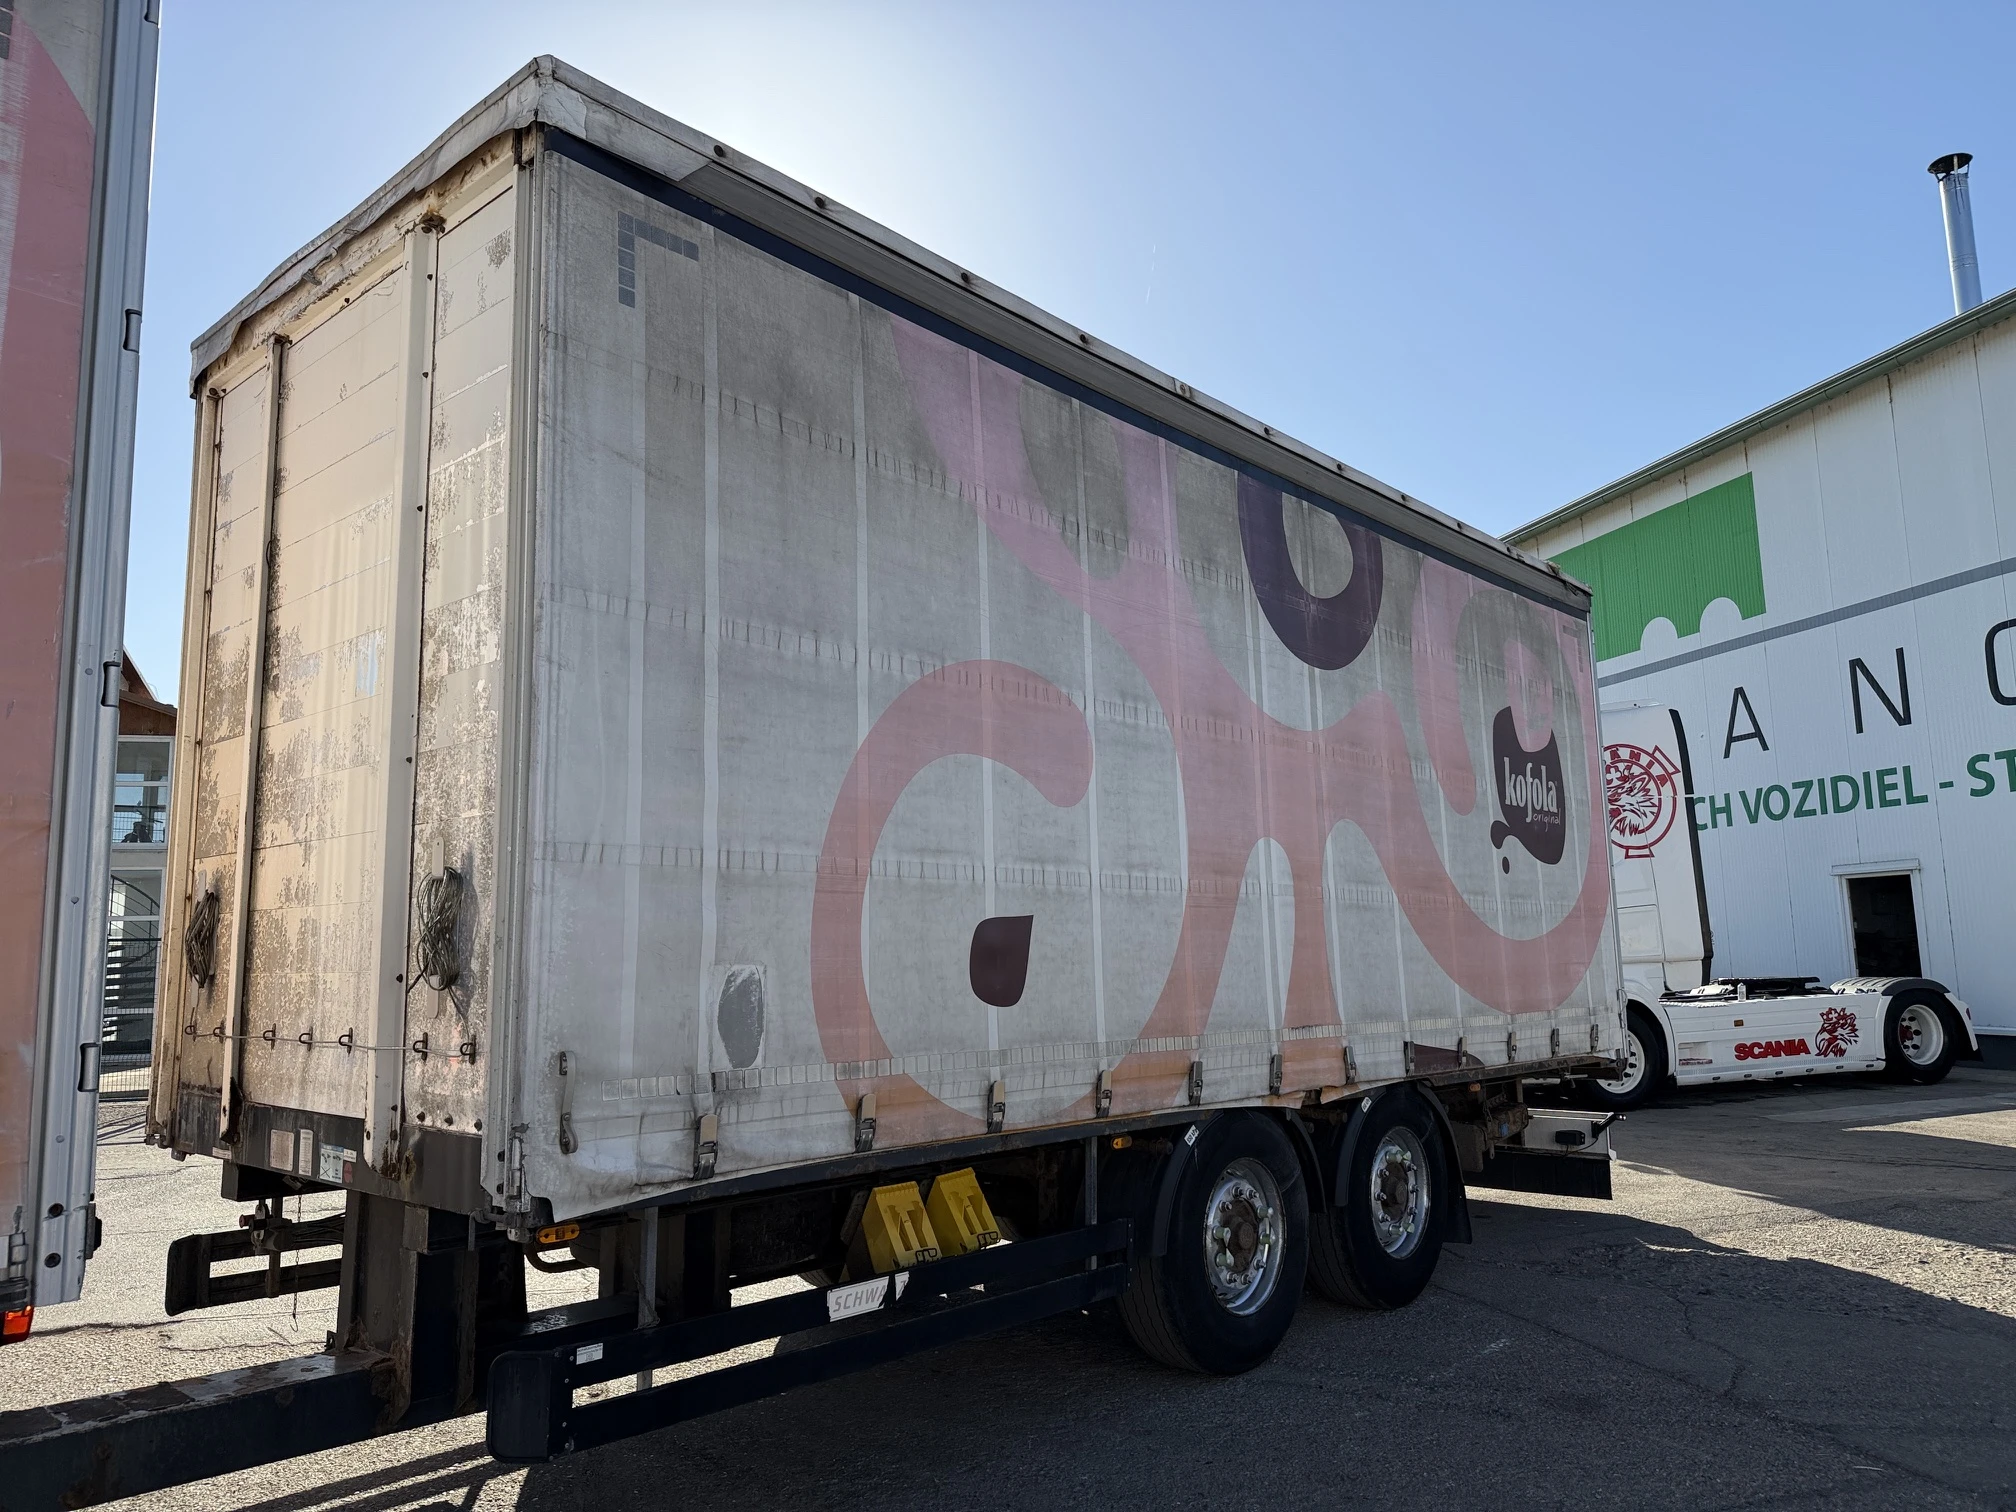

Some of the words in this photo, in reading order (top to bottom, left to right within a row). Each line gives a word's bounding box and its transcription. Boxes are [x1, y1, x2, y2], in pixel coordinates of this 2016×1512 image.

[1503, 756, 1558, 823] kofola
[1738, 765, 1929, 824] VOZIDIEL
[1532, 807, 1561, 833] original
[1734, 1038, 1811, 1061] SCANIA
